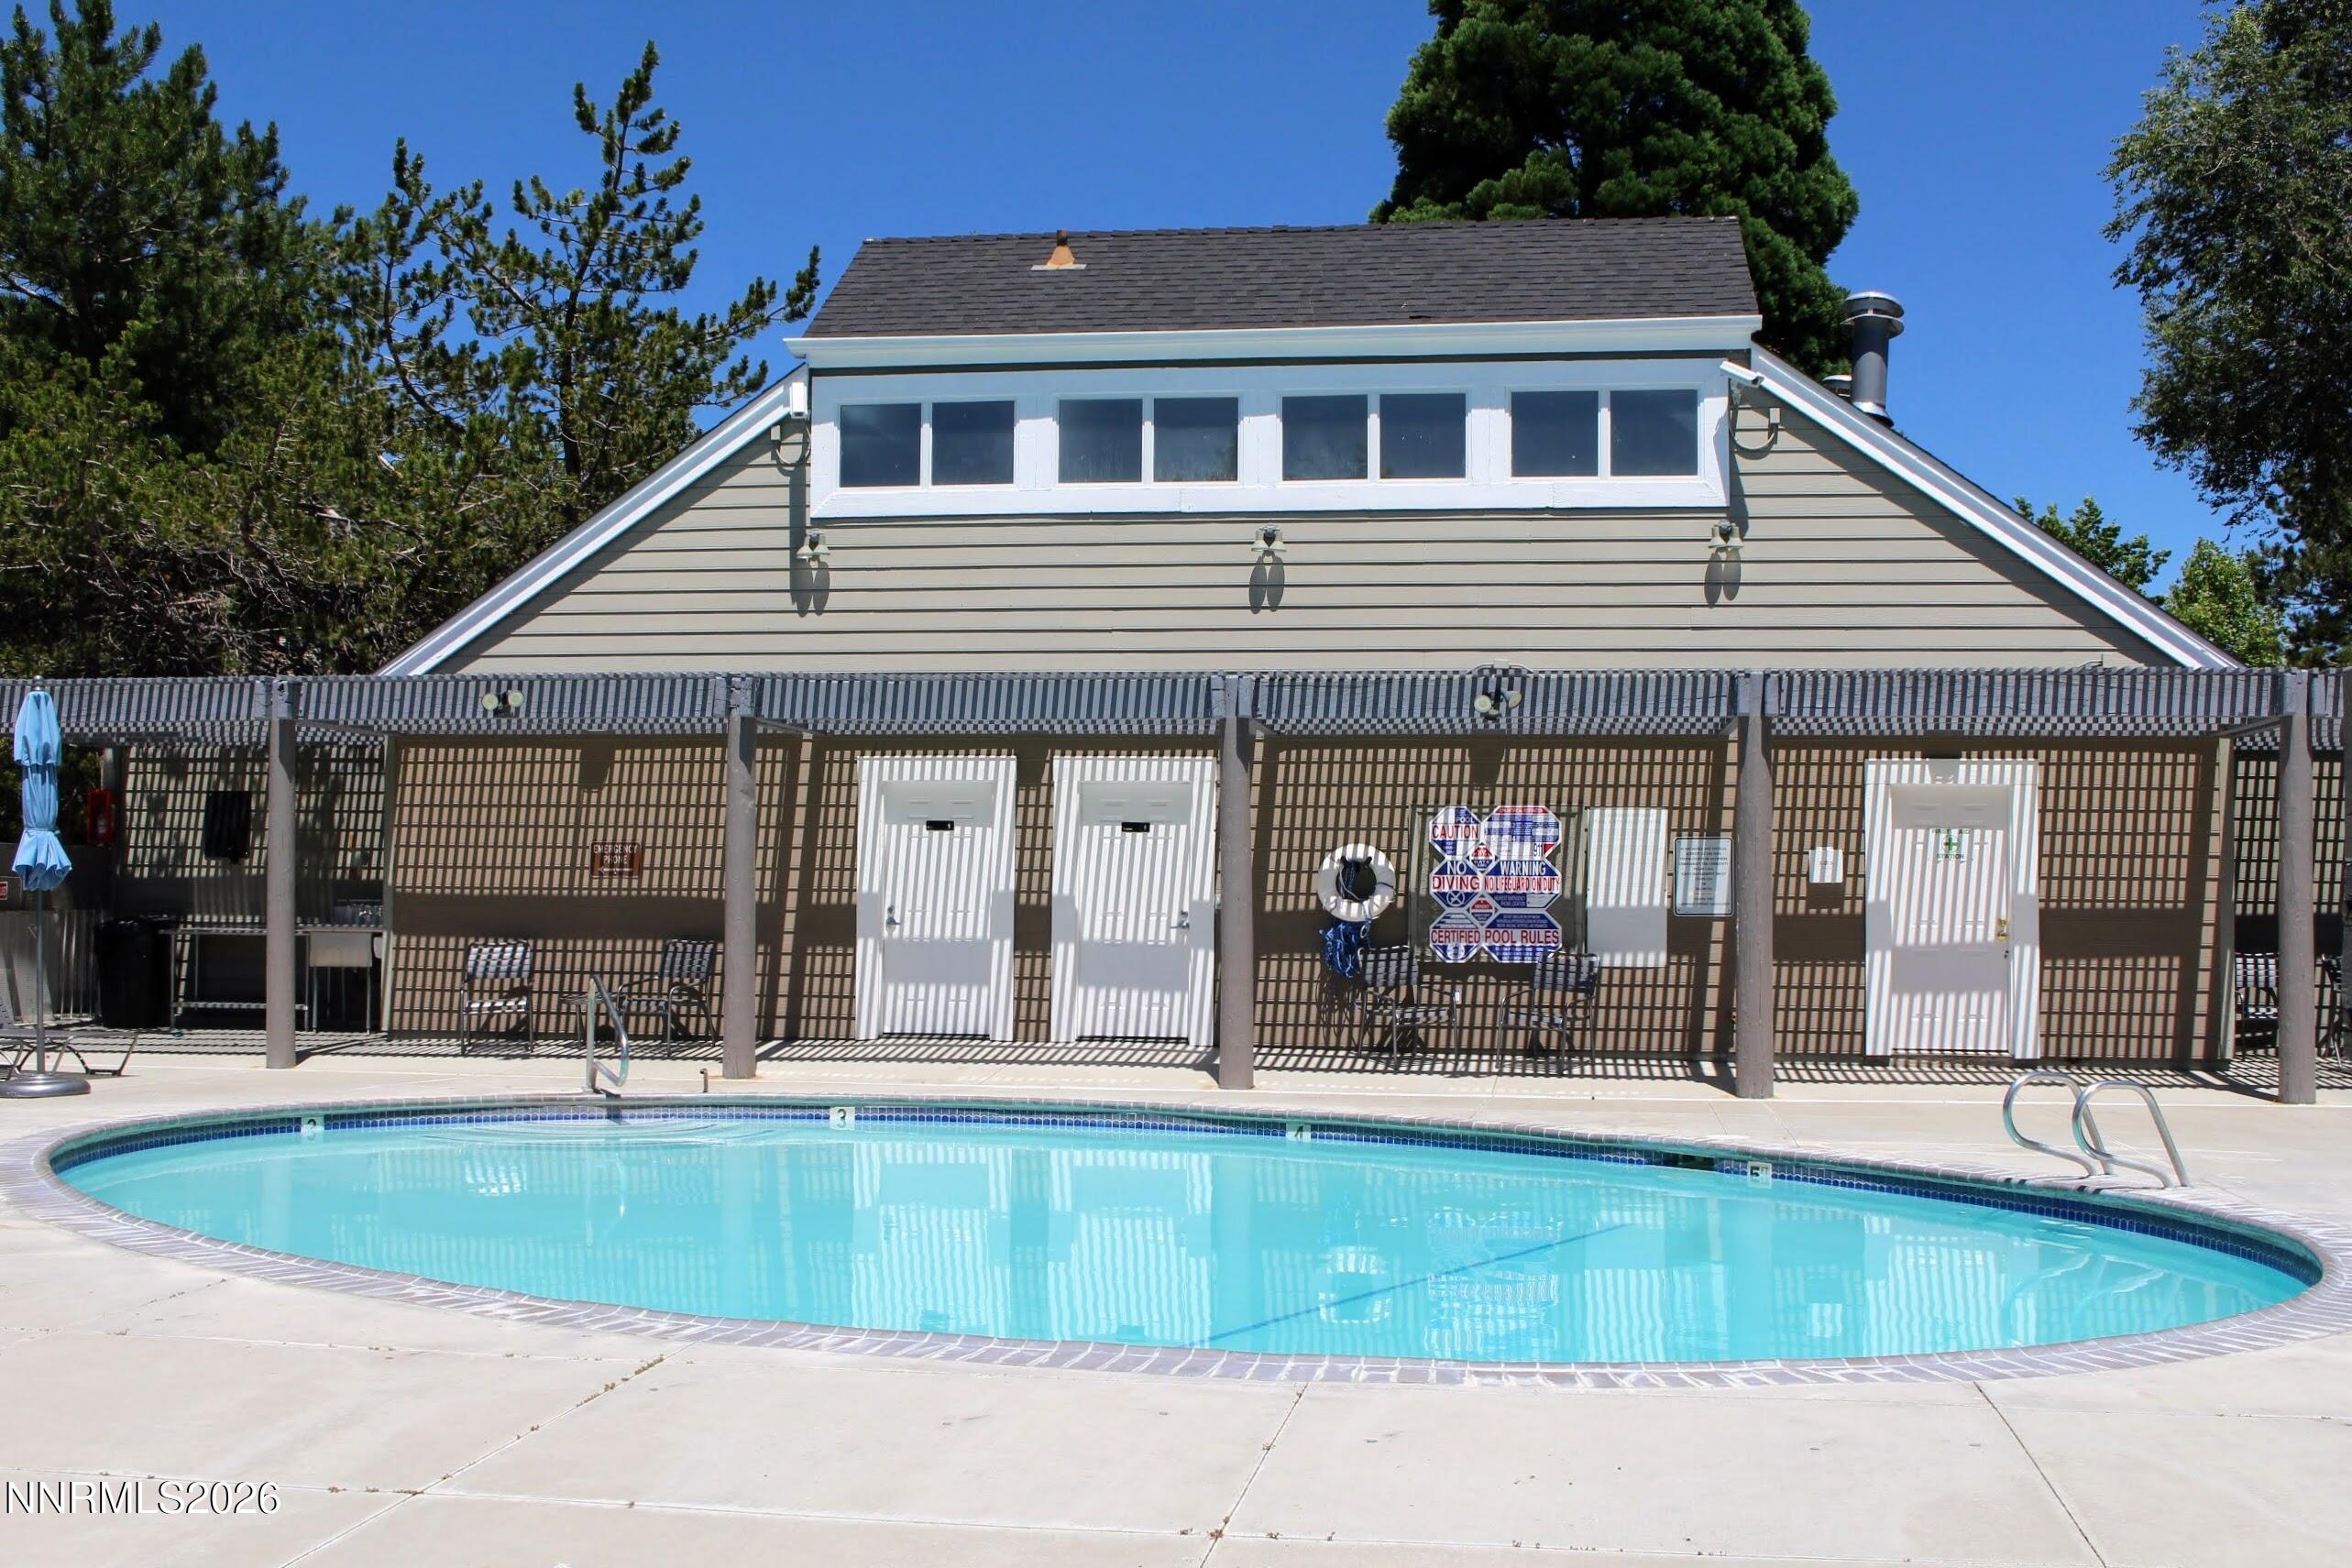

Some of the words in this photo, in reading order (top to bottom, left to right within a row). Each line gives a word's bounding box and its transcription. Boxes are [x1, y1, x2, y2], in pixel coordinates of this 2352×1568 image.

[1456, 816, 1476, 824] POOL
[1432, 825, 1478, 839] CAUTION
[593, 844, 638, 854] EMERGENCY
[1533, 842, 1544, 857] 911
[603, 854, 628, 864] PHONE
[1446, 860, 1467, 875] NO
[1500, 861, 1546, 876] WARNING
[1432, 876, 1480, 890] DIVING
[1485, 877, 1494, 891] NO
[1496, 877, 1530, 891] LIFEGUARD
[1532, 877, 1542, 891] ON
[1543, 877, 1561, 891] DUTY
[1431, 930, 1481, 944] CERTIFIED
[1485, 929, 1517, 944] POOL
[1521, 929, 1560, 945] RULES
